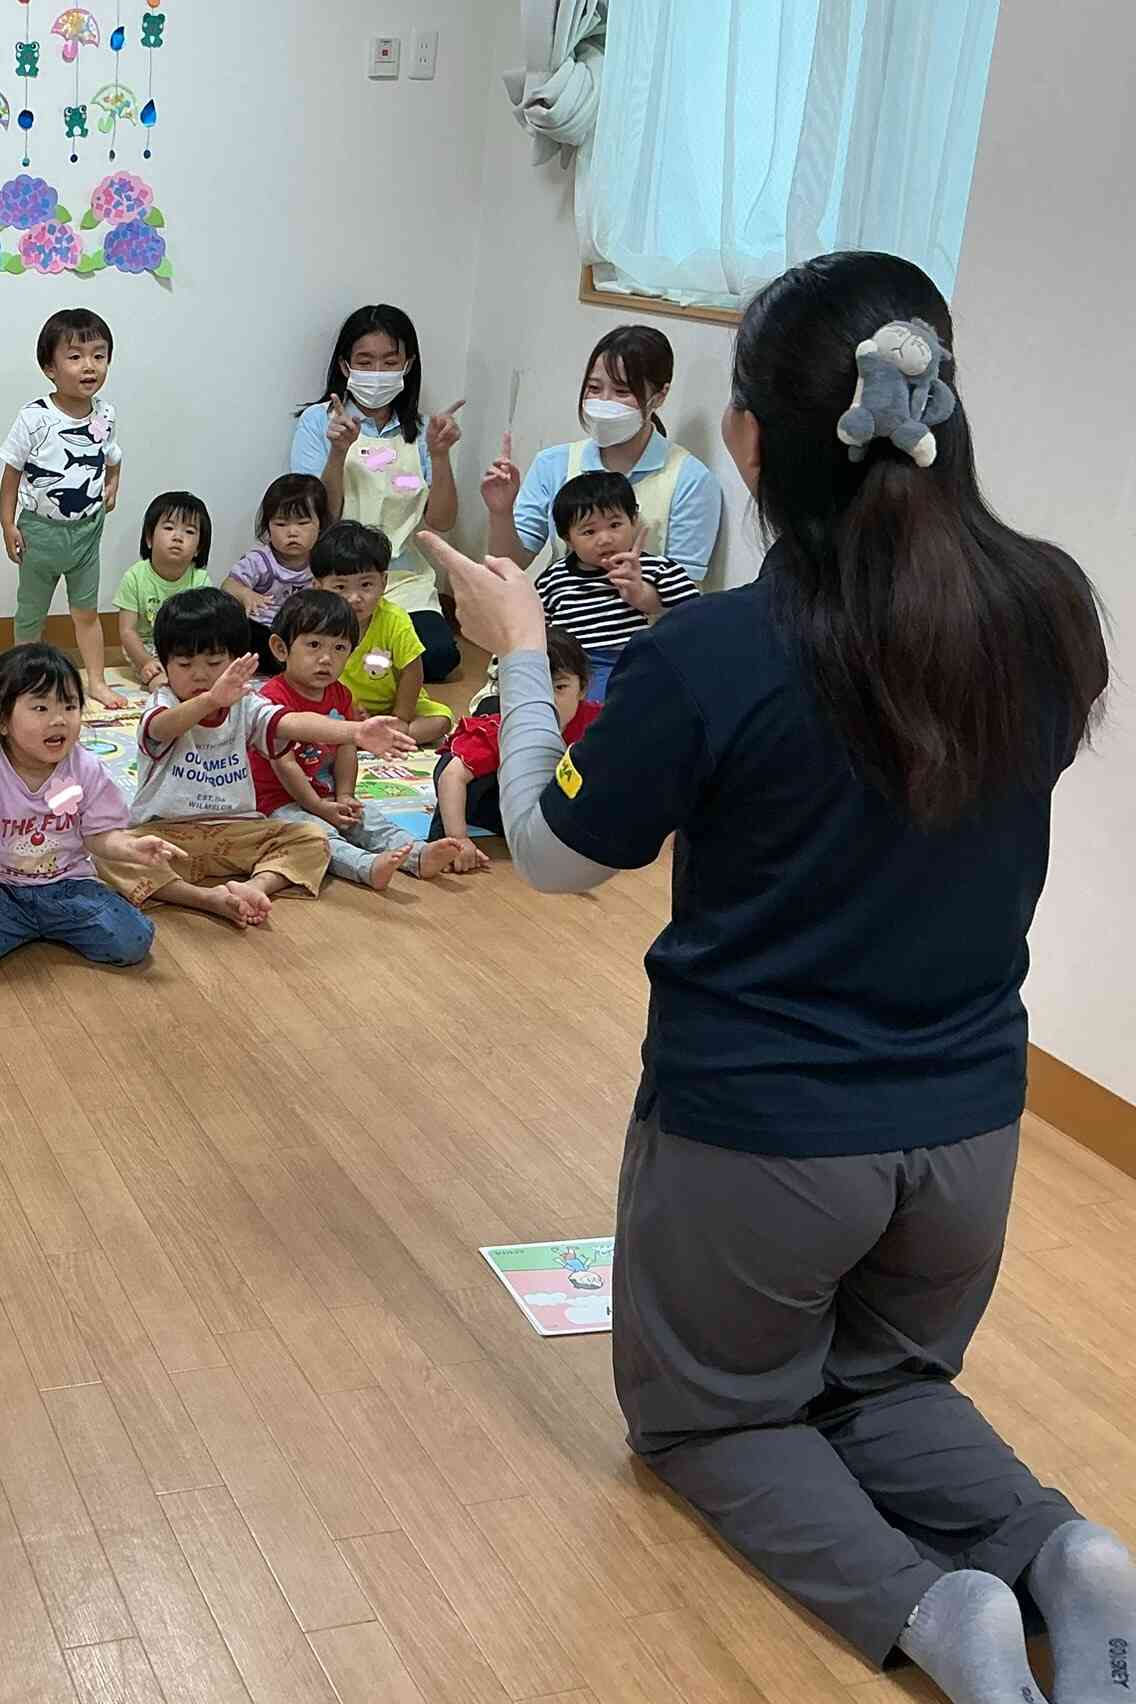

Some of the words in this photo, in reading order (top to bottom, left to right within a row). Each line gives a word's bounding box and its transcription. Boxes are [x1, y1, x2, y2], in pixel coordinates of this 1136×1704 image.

[185, 752, 202, 765] OU
[203, 758, 227, 772] AME
[228, 753, 240, 767] IS
[172, 765, 185, 779] IN
[208, 767, 248, 787] ROUND
[1, 816, 37, 838] THE
